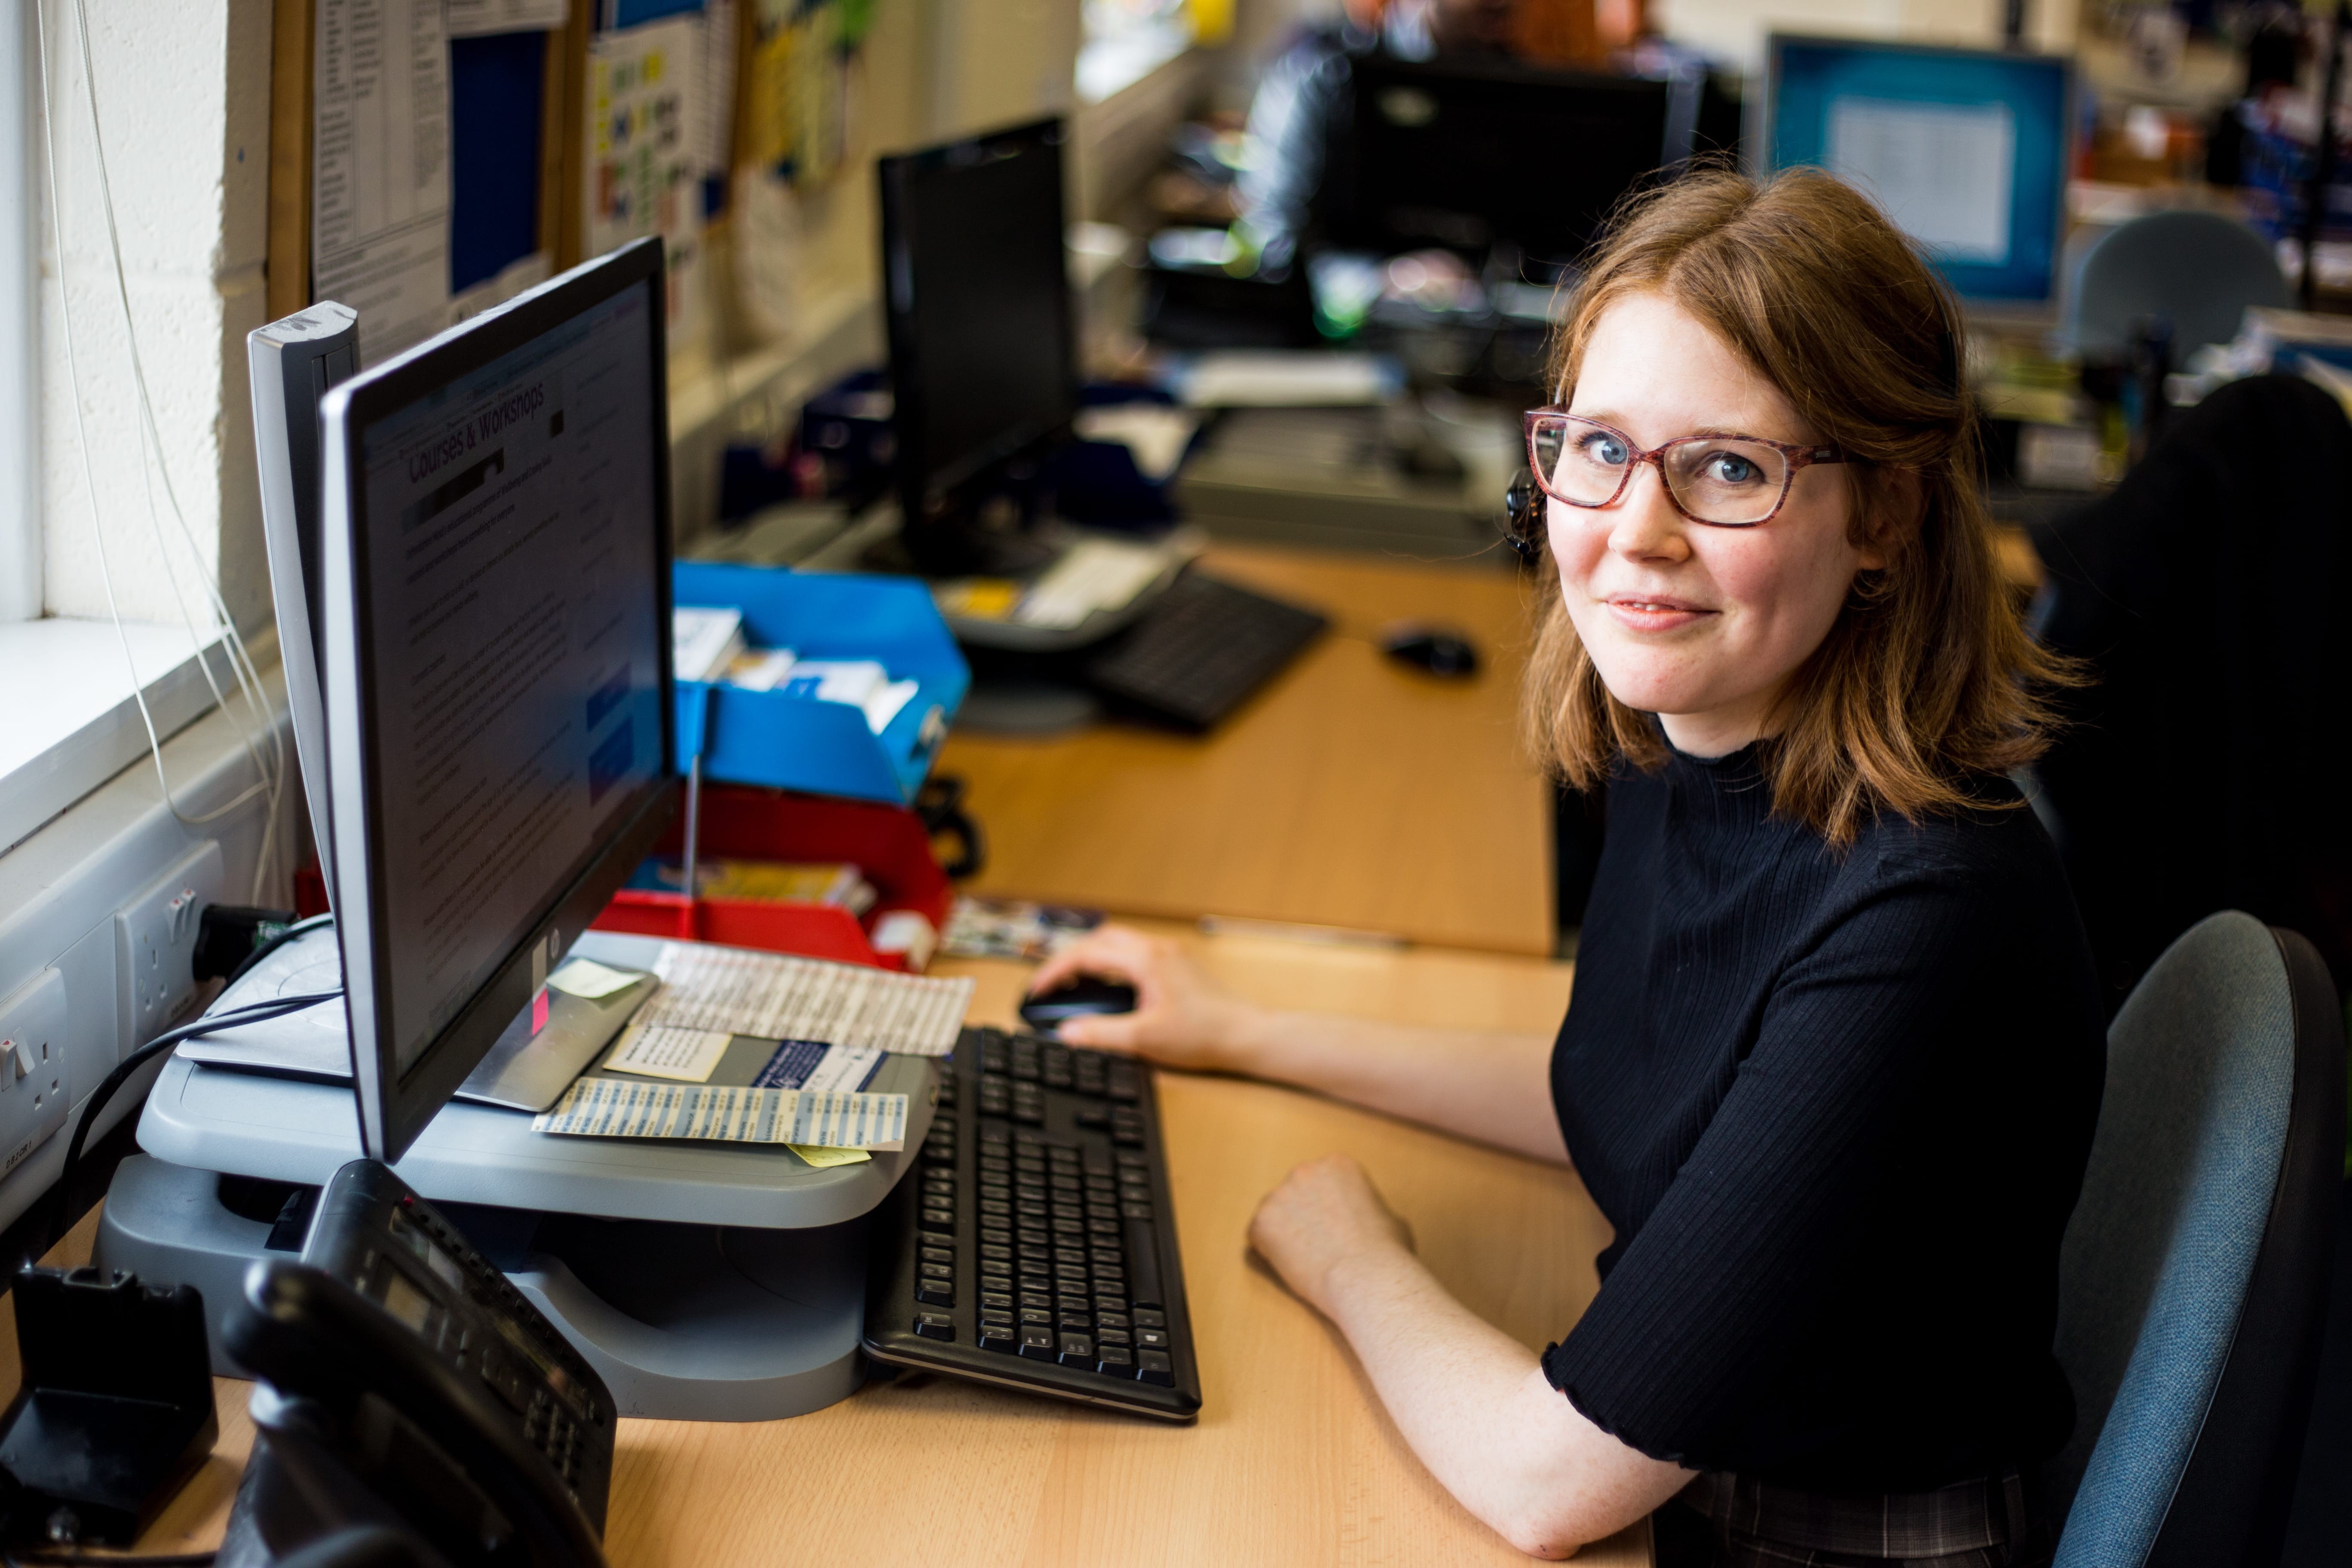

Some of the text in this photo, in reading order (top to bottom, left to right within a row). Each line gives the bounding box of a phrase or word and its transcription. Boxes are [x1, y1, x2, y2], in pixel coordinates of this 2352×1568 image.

[409, 430, 463, 485] Courses
[467, 421, 475, 450] &
[480, 383, 544, 441] Workshops
[447, 506, 472, 531] educational
[472, 493, 496, 517] programme
[458, 535, 468, 548] have
[469, 520, 490, 541] something
